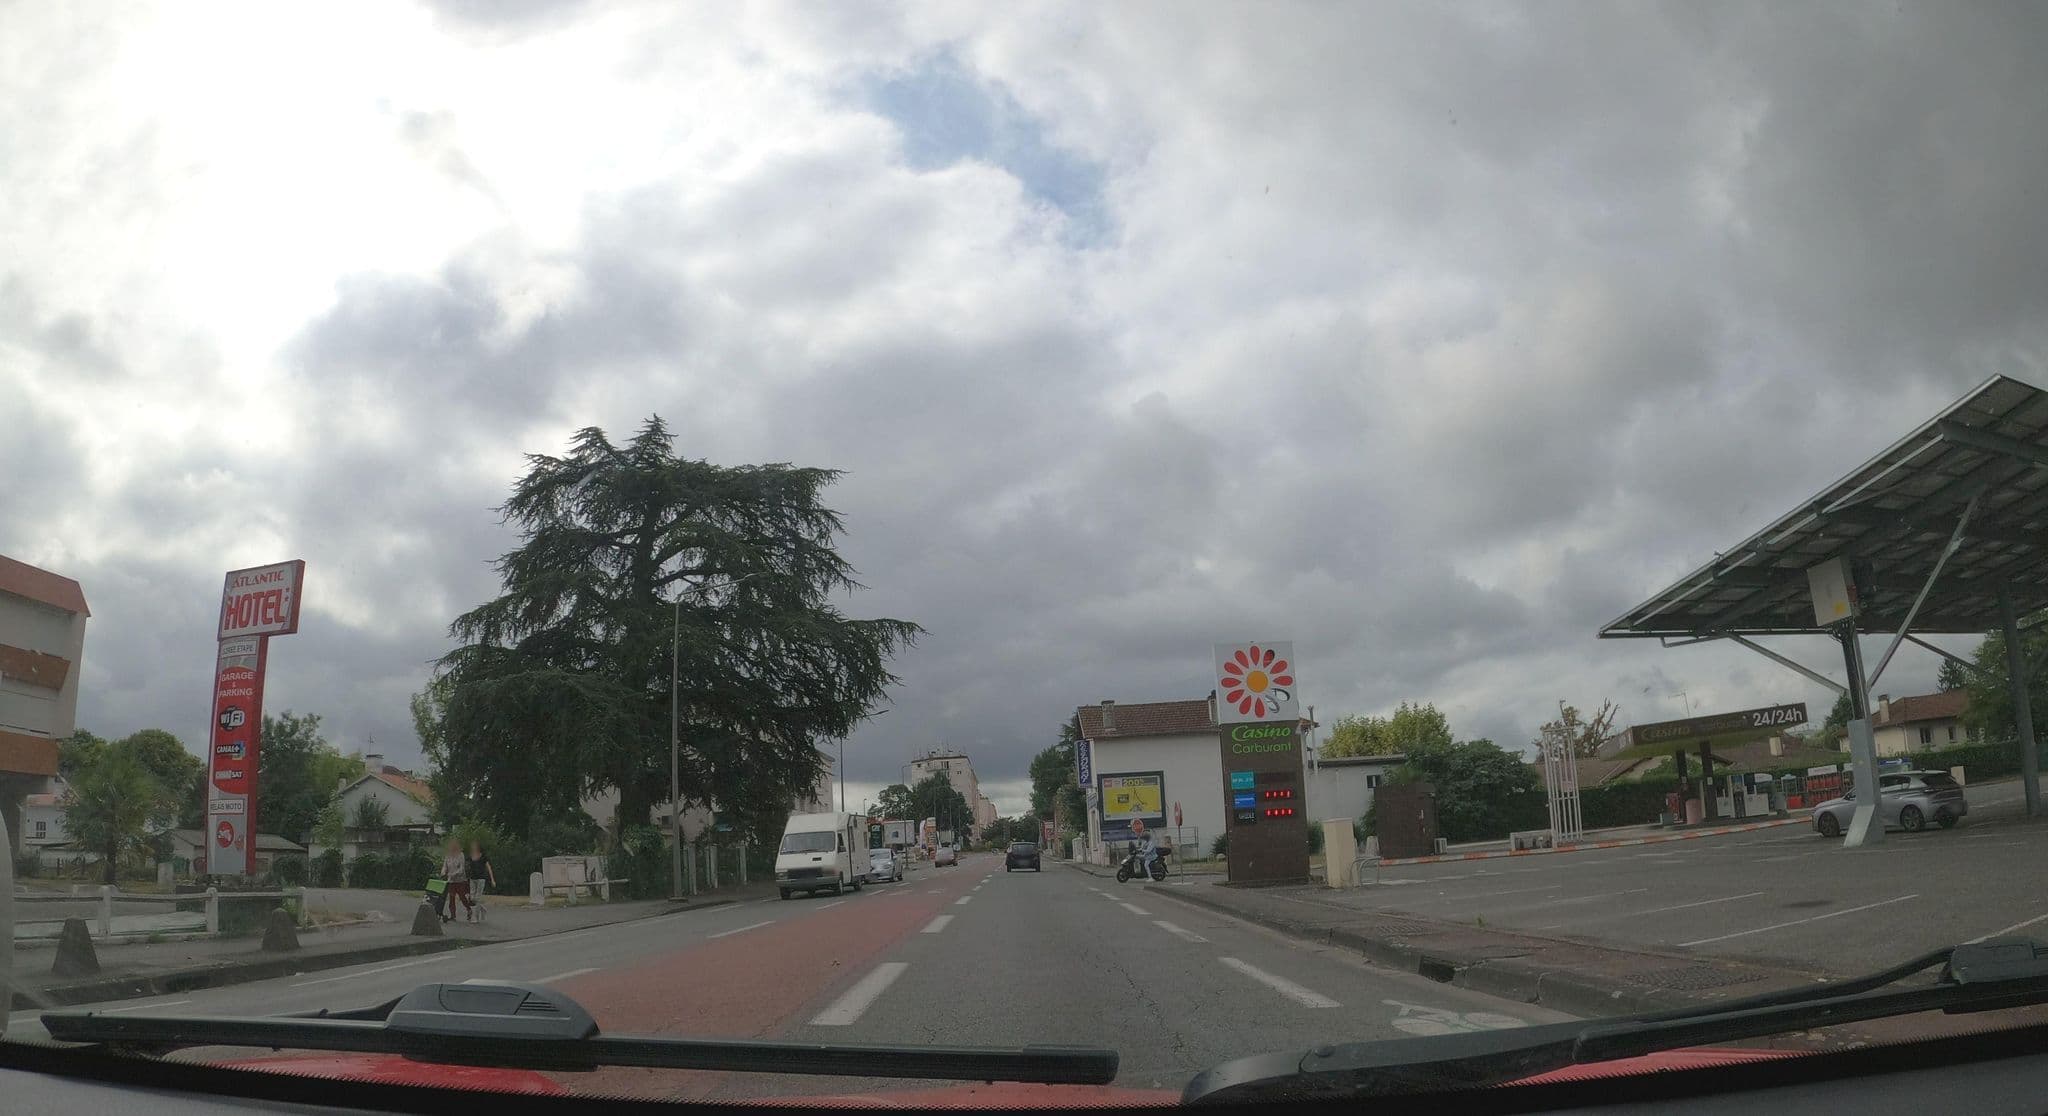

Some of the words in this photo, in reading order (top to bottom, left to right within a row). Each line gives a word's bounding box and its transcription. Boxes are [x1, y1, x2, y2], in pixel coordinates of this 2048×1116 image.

[233, 570, 285, 587] ATLANTIC
[224, 588, 286, 631] HOTEL
[222, 671, 254, 681] GARAGE
[219, 687, 253, 697] PARKING
[1752, 708, 1803, 726] 24/24h
[1232, 724, 1291, 742] Casino
[1232, 742, 1291, 754] Carburant
